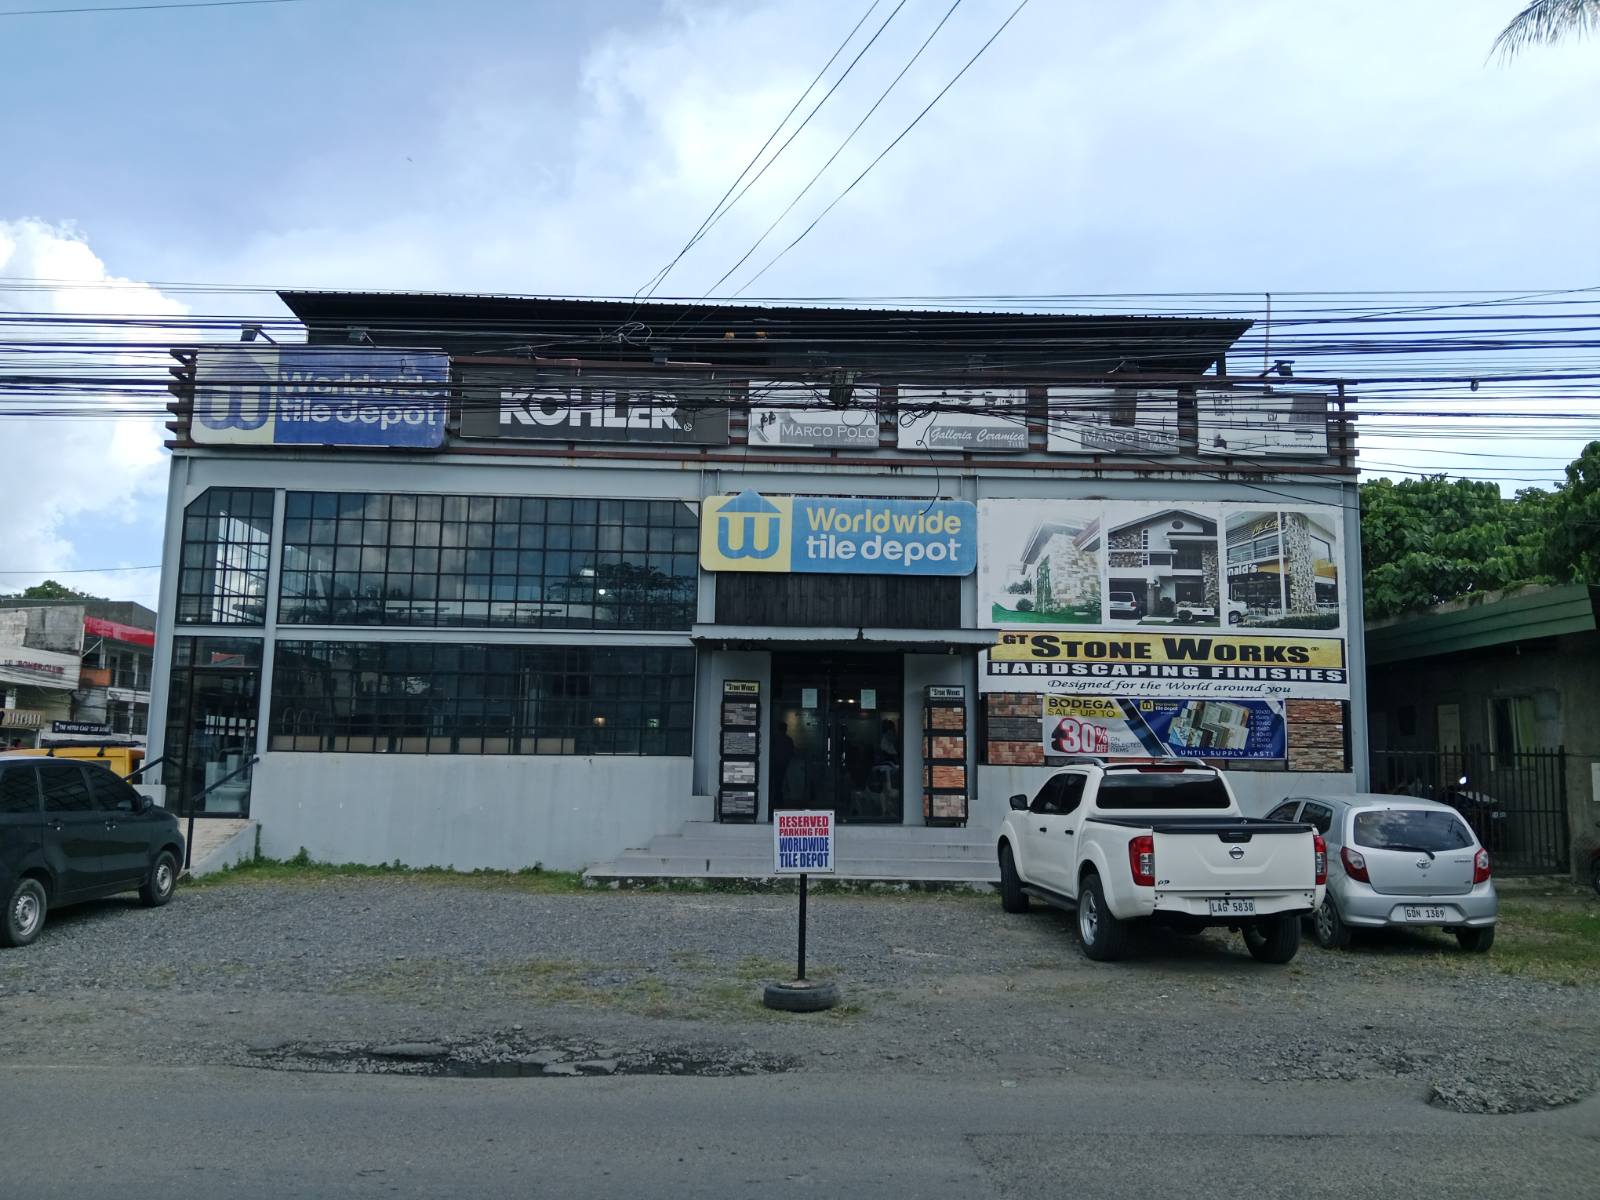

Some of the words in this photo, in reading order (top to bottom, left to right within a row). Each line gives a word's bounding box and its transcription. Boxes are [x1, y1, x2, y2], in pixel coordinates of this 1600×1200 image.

[335, 399, 439, 430] depot
[499, 387, 682, 430] KOHLER
[781, 425, 834, 438] MARCO
[837, 424, 877, 438] POLO
[930, 428, 973, 441] Galleria
[976, 428, 1025, 443] Ceramica
[1083, 430, 1135, 443] MARCO
[1138, 430, 1177, 443] POLO
[806, 507, 962, 534] Worldwide
[806, 534, 856, 560] tile
[860, 535, 962, 567] depot
[1002, 634, 1029, 645] GT
[1031, 634, 1152, 660] STONE
[1162, 637, 1310, 664] WORKS
[991, 662, 1200, 679] HARDSCAPING
[1211, 666, 1345, 682] FINISHES
[1047, 679, 1112, 692] Designed
[1115, 679, 1138, 692] for
[1141, 681, 1161, 691] the
[1164, 680, 1210, 692] World
[1212, 682, 1265, 693] around
[1266, 685, 1292, 695] you
[1048, 698, 1115, 710] BODEGA
[1047, 708, 1077, 717] SALE
[1080, 709, 1097, 718] UP
[1098, 709, 1116, 718] TO
[1096, 744, 1109, 753] OFF
[779, 815, 829, 828] RESERVED
[779, 827, 813, 837] PARKING
[814, 827, 829, 836] FOR
[779, 836, 829, 853] WORLDWIDE
[779, 852, 798, 868] TILE
[799, 852, 829, 868] DEPOT
[1211, 902, 1229, 913] LAG
[1232, 902, 1255, 913] 5838
